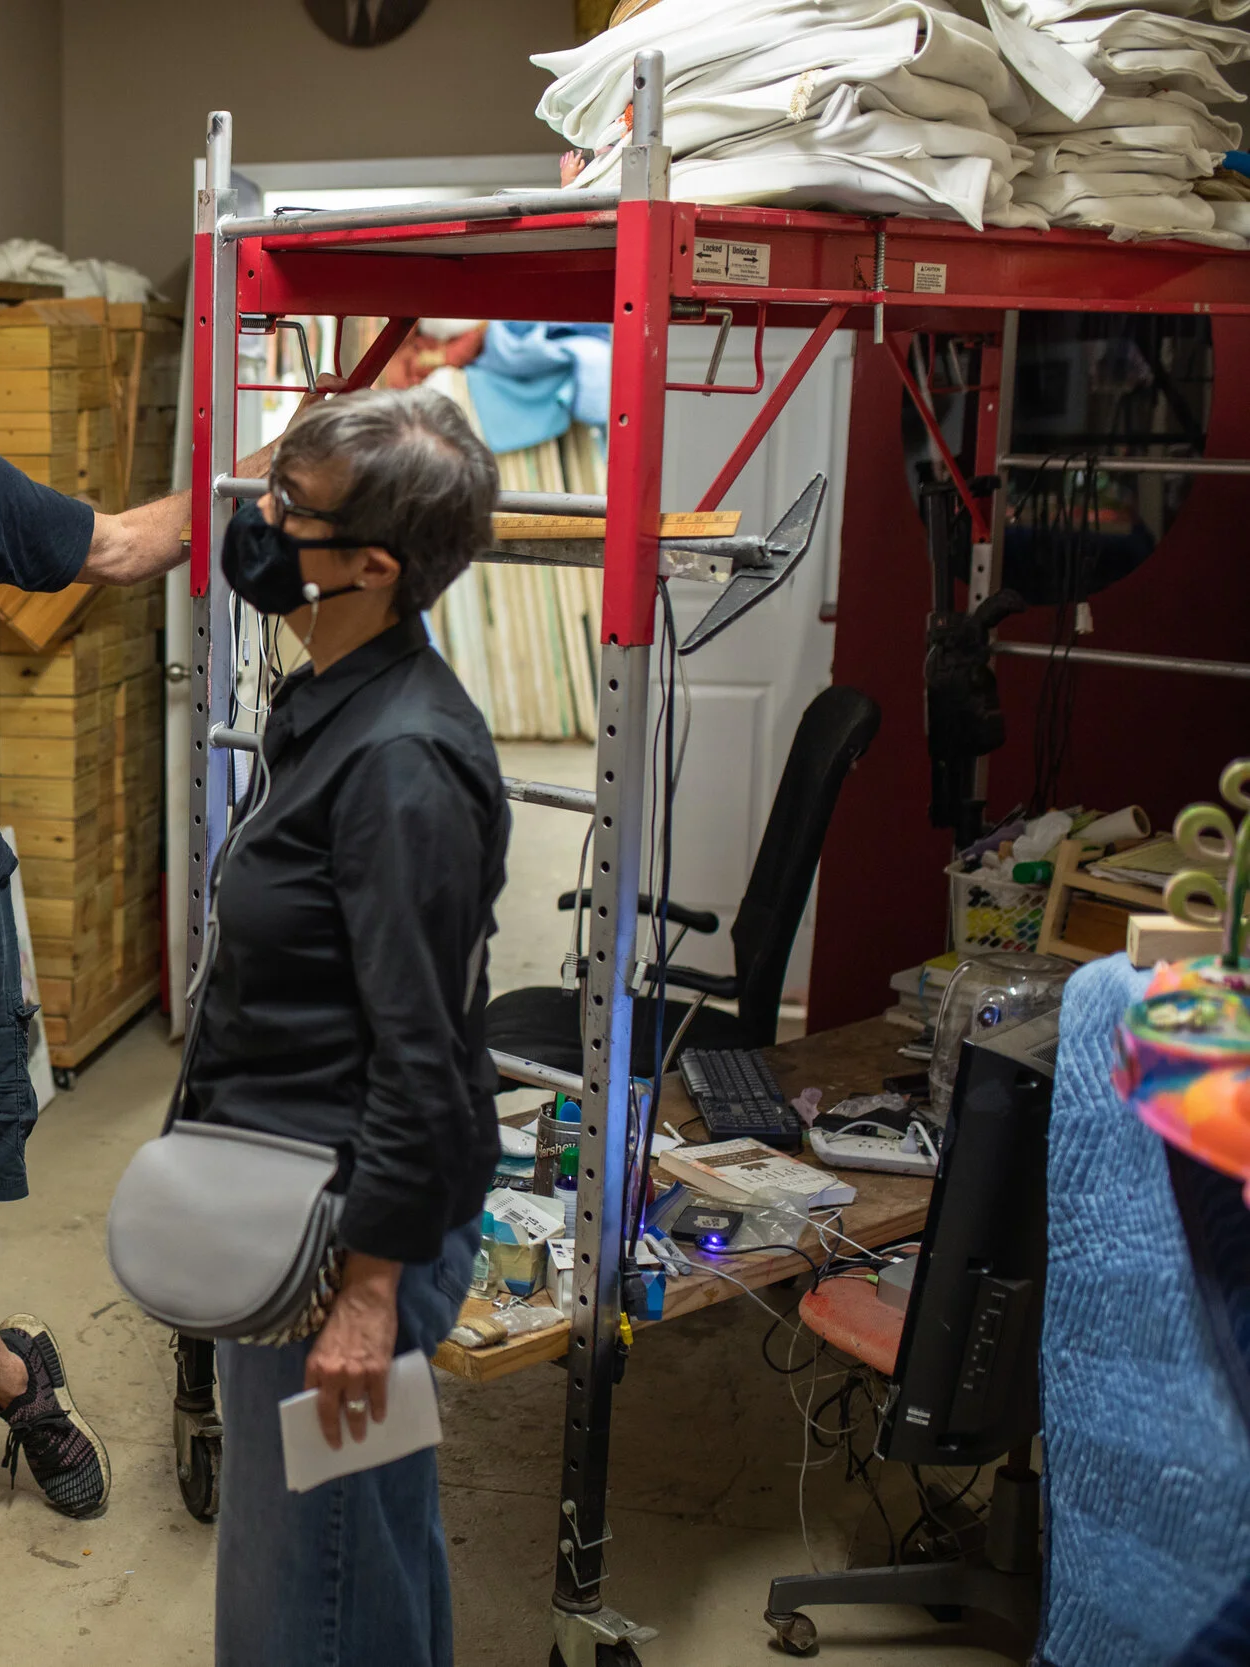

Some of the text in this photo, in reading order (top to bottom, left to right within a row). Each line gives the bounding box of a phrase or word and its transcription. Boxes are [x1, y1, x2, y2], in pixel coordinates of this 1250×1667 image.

[702, 243, 723, 253] Locked
[732, 246, 757, 256] Unlocked
[741, 1166, 809, 1184] SPIRIT
